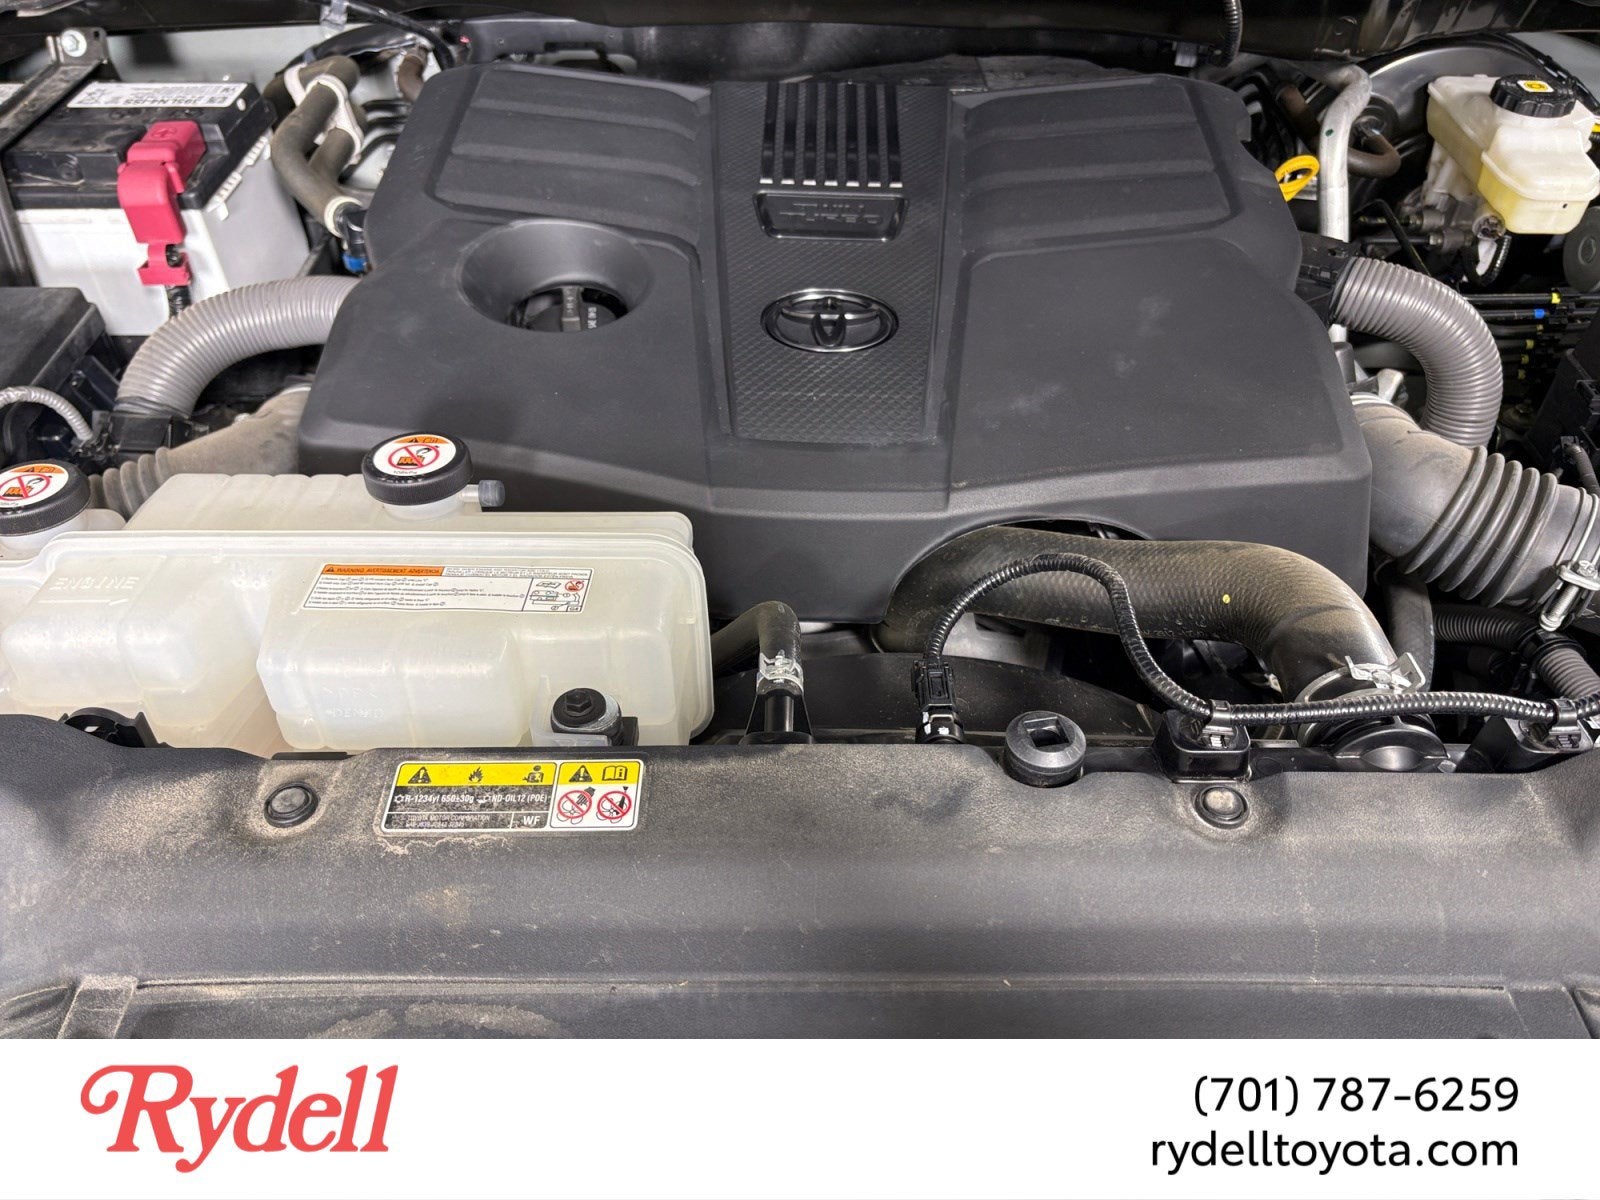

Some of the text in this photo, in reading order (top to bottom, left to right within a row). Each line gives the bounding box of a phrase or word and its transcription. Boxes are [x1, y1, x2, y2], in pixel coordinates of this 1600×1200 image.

[49, 576, 139, 590] ENGINE
[527, 793, 548, 804] (POE)
[523, 815, 541, 826] WF
